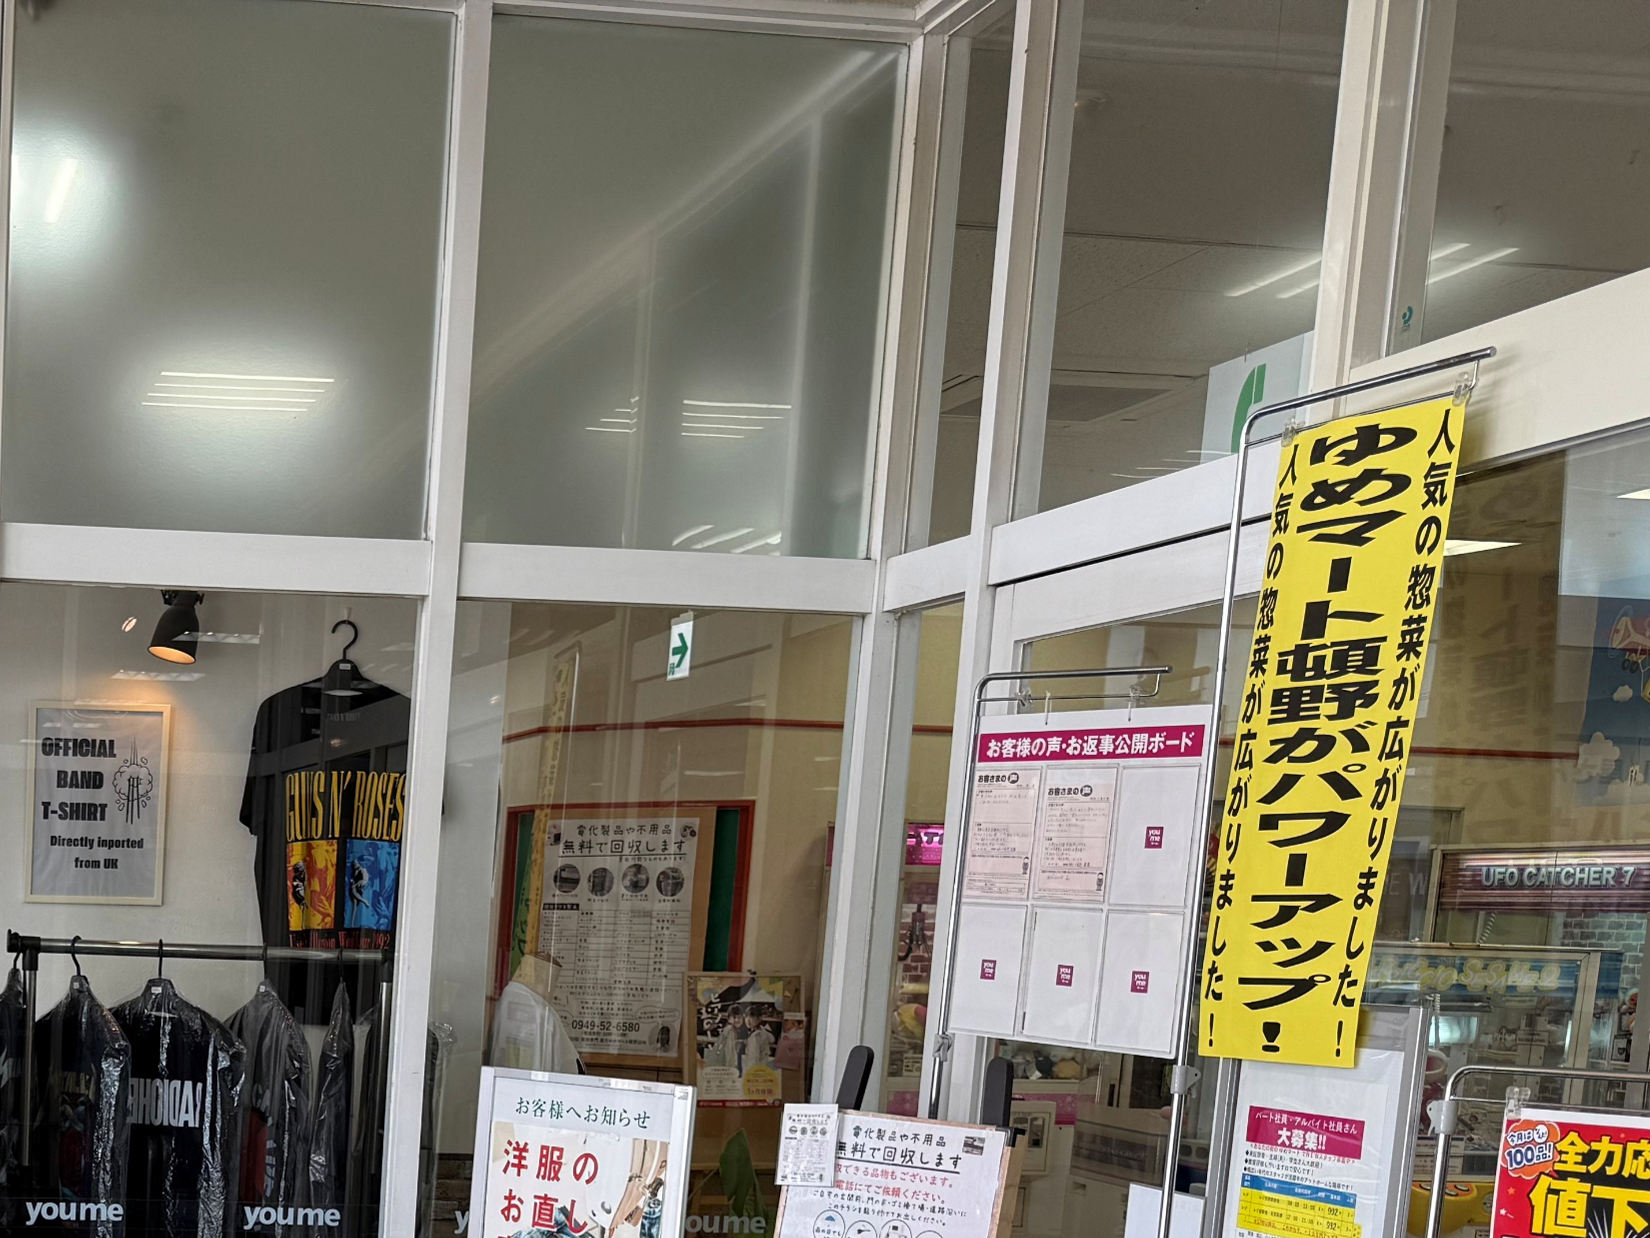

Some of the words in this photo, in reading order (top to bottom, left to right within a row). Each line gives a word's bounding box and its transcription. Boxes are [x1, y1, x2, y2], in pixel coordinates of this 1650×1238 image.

[41, 736, 116, 759] OFFICIAL
[986, 731, 1195, 758] お客様の声・お返事公開ボード
[56, 770, 104, 792] BAND
[41, 801, 108, 823] T-SHIRT
[286, 771, 325, 842] GUNS
[351, 771, 407, 841] ROSES
[577, 824, 671, 837] 電化製品や不用品
[50, 834, 92, 850] Directly
[562, 839, 686, 854] 無料で回収します
[74, 856, 100, 870] from
[103, 856, 119, 870] UK
[1482, 867, 1519, 886] UFO
[1523, 867, 1616, 886] CATCHER
[1622, 867, 1636, 885] 7
[572, 1020, 640, 1032] 0949-52-6580
[516, 1096, 651, 1131] お客様へお知らせ
[853, 1125, 946, 1147] 電化製品や不用品
[501, 1138, 599, 1186] 洋服の
[26, 1202, 124, 1226] youme
[244, 1204, 341, 1230] youme
[501, 1188, 589, 1235] お直し
